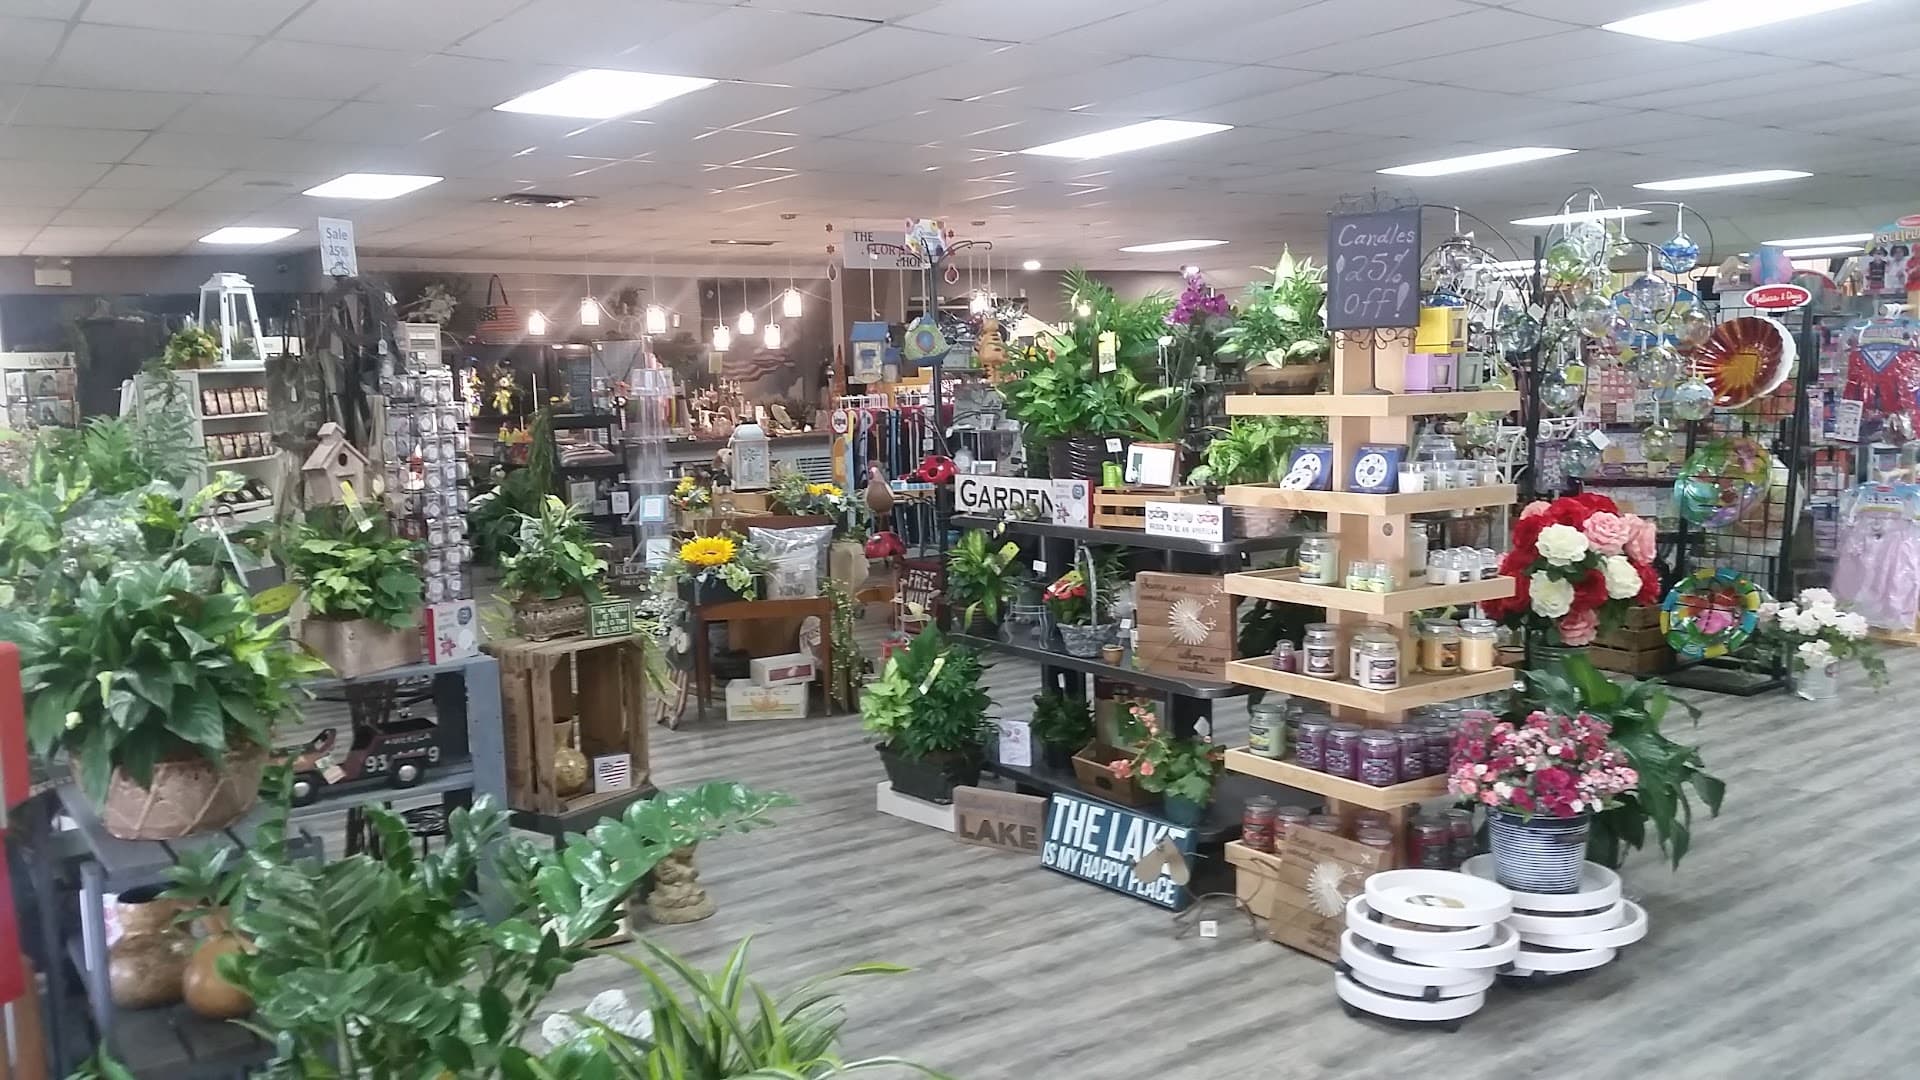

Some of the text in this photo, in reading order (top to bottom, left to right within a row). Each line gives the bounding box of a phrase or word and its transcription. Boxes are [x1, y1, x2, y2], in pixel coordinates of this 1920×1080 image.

[326, 227, 348, 240] Sale
[853, 231, 874, 242] THE
[1338, 223, 1416, 247] Candles
[1345, 248, 1410, 283] 25%
[908, 569, 937, 591] FREE
[364, 753, 389, 774] 93
[959, 813, 1038, 850] LAKE
[1050, 796, 1106, 853] THE
[1041, 840, 1058, 866] IS
[1056, 845, 1082, 873] MY
[1079, 854, 1129, 888] HAPPY
